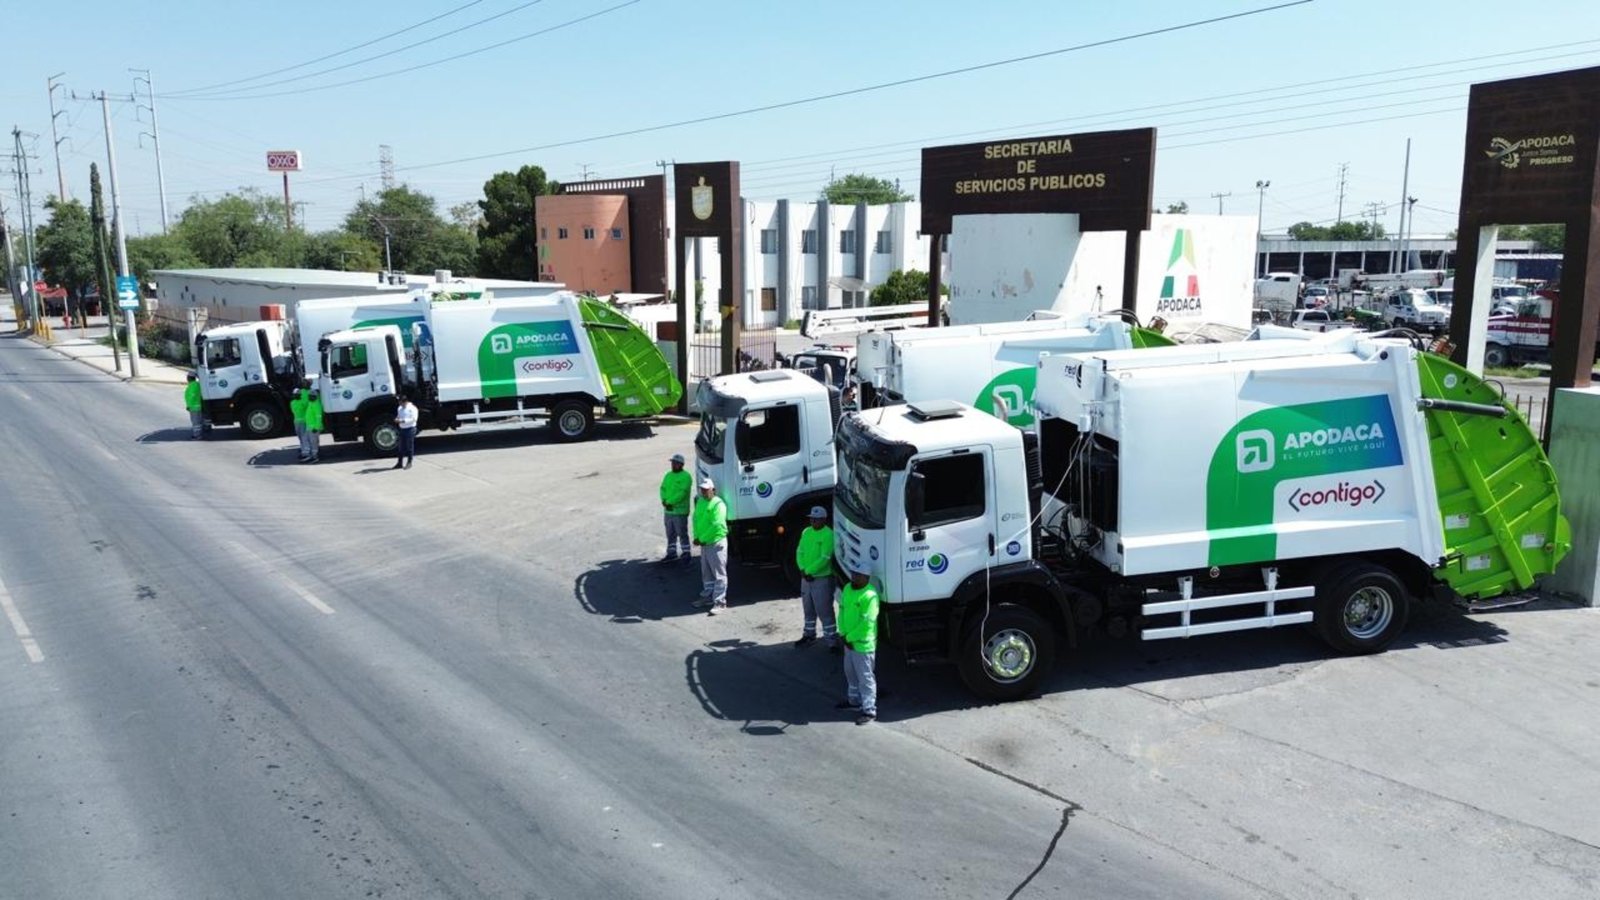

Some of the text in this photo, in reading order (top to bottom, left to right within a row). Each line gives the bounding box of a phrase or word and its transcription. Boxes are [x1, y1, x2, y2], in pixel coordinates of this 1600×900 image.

[1520, 134, 1575, 148] APODACA
[984, 139, 1073, 159] SECRETARIA
[268, 155, 298, 167] OXXO
[1017, 160, 1036, 174] DE
[1529, 155, 1574, 165] PROGRESO
[955, 173, 1106, 194] SERVICIOS PUBLICOS
[1156, 297, 1202, 312] APODACA
[516, 332, 569, 344] APODACA
[1064, 364, 1077, 376] red
[1283, 422, 1384, 450] APODACA
[1283, 453, 1294, 461] EL
[1298, 448, 1334, 458] FUTURO
[1339, 445, 1359, 453] VIVE
[905, 558, 925, 569] red
